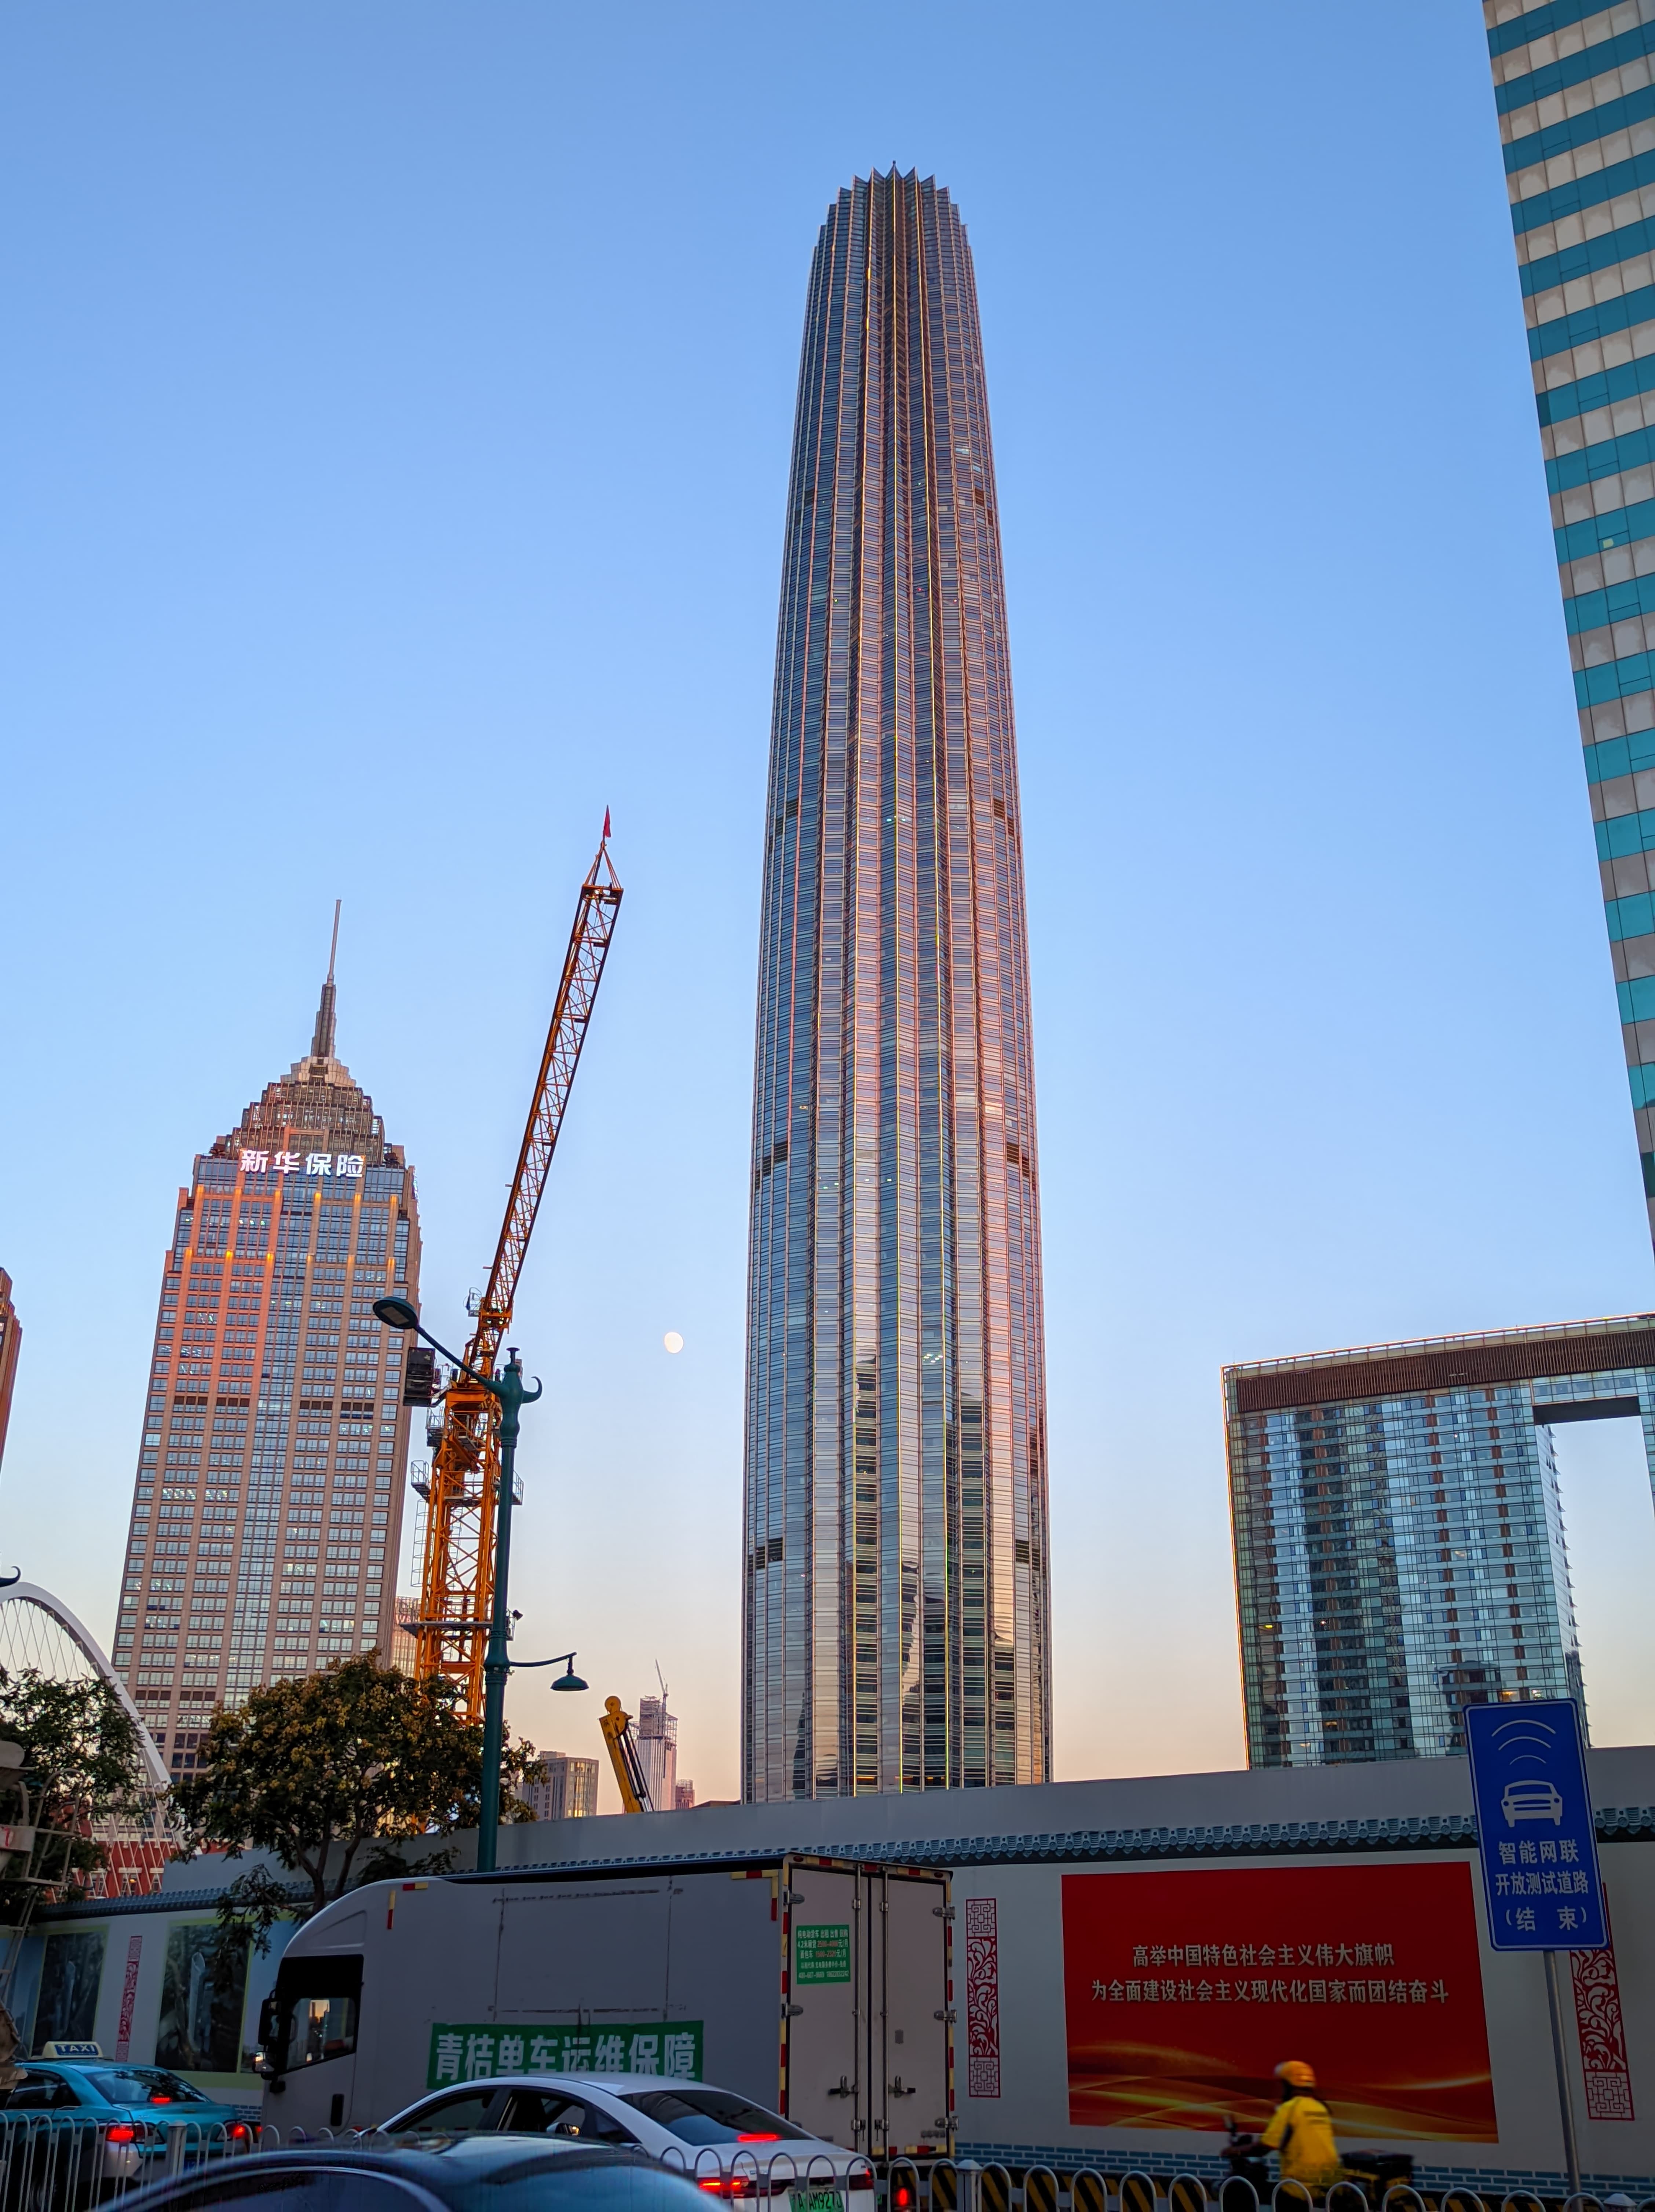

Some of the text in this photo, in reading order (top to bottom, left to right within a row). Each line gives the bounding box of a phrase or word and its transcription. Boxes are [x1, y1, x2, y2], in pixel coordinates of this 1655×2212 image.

[240, 1149, 364, 1178] 新华保险
[1498, 1839, 1579, 1865] 智能网联
[1495, 1870, 1589, 1896] 开放测试道路
[1132, 1943, 1395, 1967] 高举中国特色社会主义伟大旗帜
[1092, 1979, 1449, 2003] 为全面建设社会主义现代化国家而团结奋斗
[436, 2032, 696, 2081] 青桔单车运维保障
